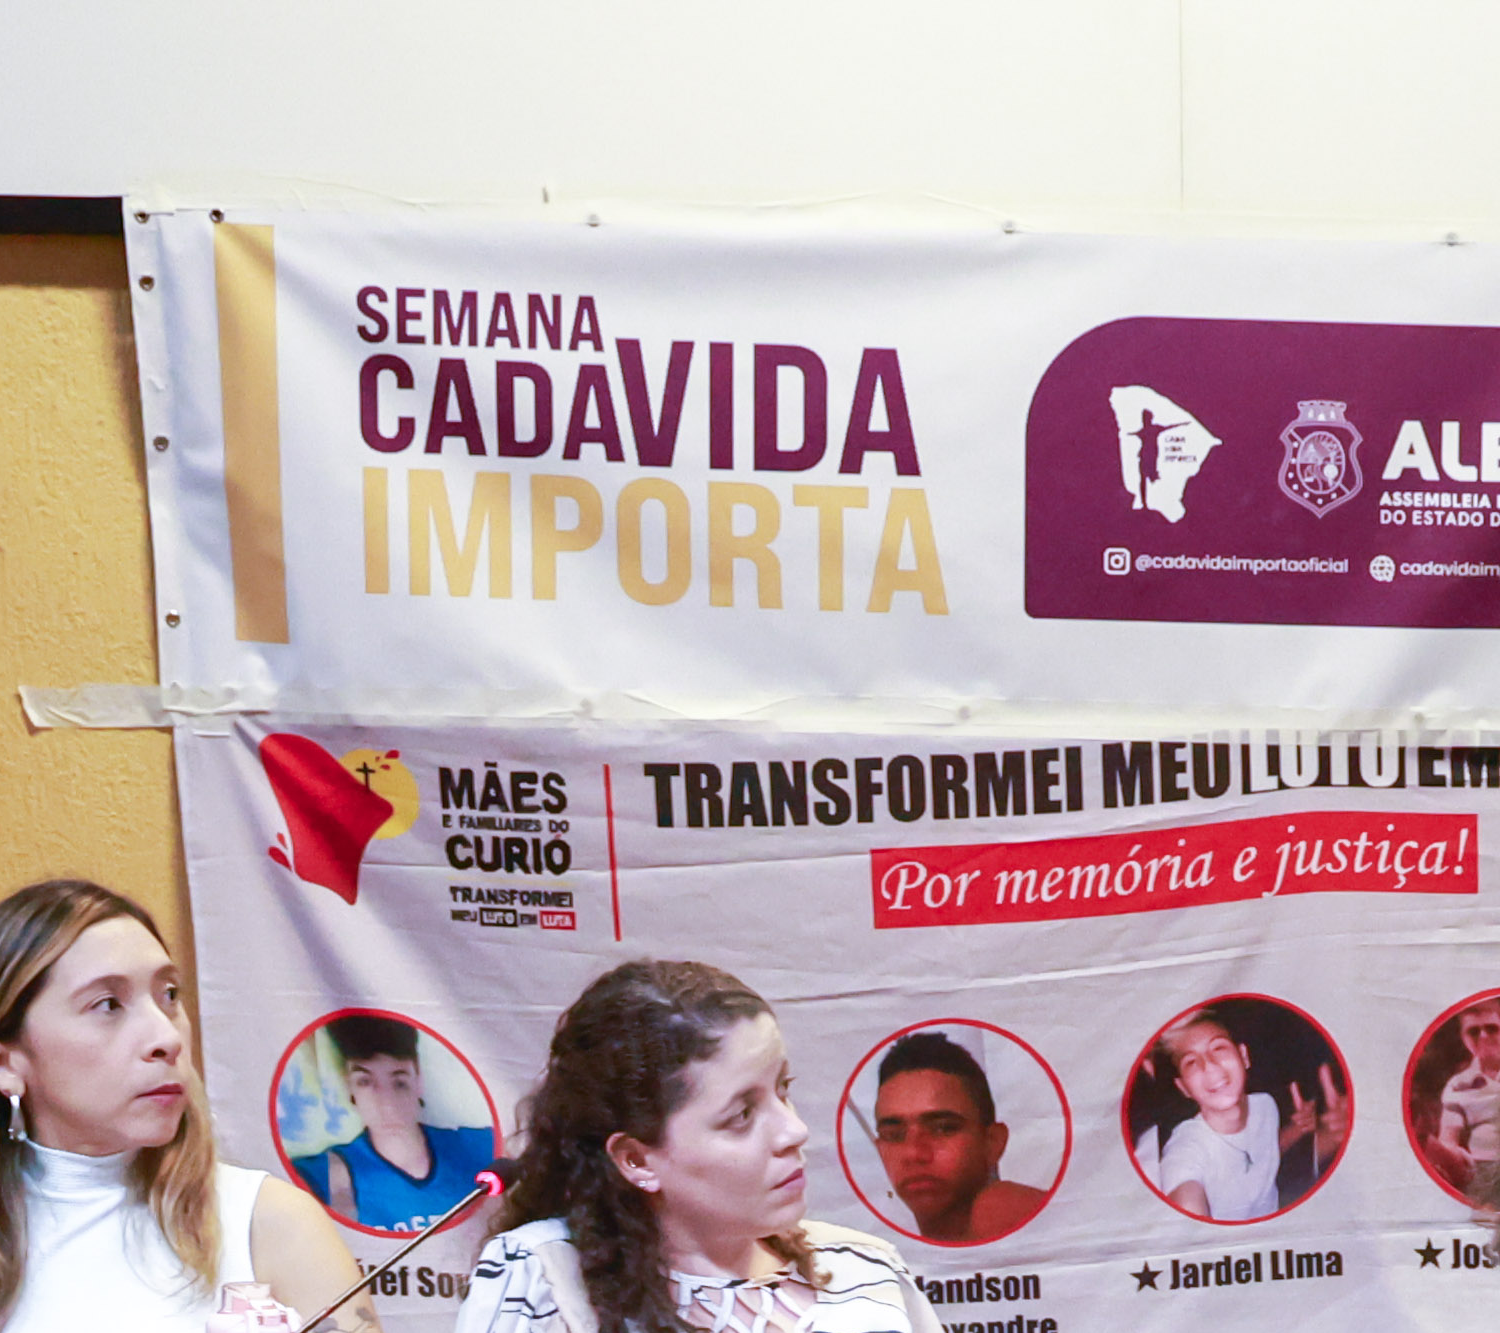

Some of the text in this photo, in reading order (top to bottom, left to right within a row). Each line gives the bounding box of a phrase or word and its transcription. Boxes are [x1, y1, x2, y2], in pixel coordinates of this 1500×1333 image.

[356, 286, 605, 352] SEMANA
[1379, 491, 1492, 509] ASSEMBLEIA
[1379, 509, 1407, 526] DO
[1412, 511, 1485, 528] ESTADO
[362, 466, 950, 616] IMPORTA
[438, 761, 569, 815] MÃES
[643, 747, 1083, 828] TRANSFORMEI
[1101, 740, 1232, 809] MEU
[1418, 733, 1500, 789] EM
[442, 814, 453, 829] E
[548, 818, 570, 833] DO
[445, 833, 572, 876] CURIÓ
[881, 823, 1470, 911] Por memória e justiça!
[450, 886, 574, 908] TRANSFORMEI
[1169, 1251, 1263, 1290] Jardel
